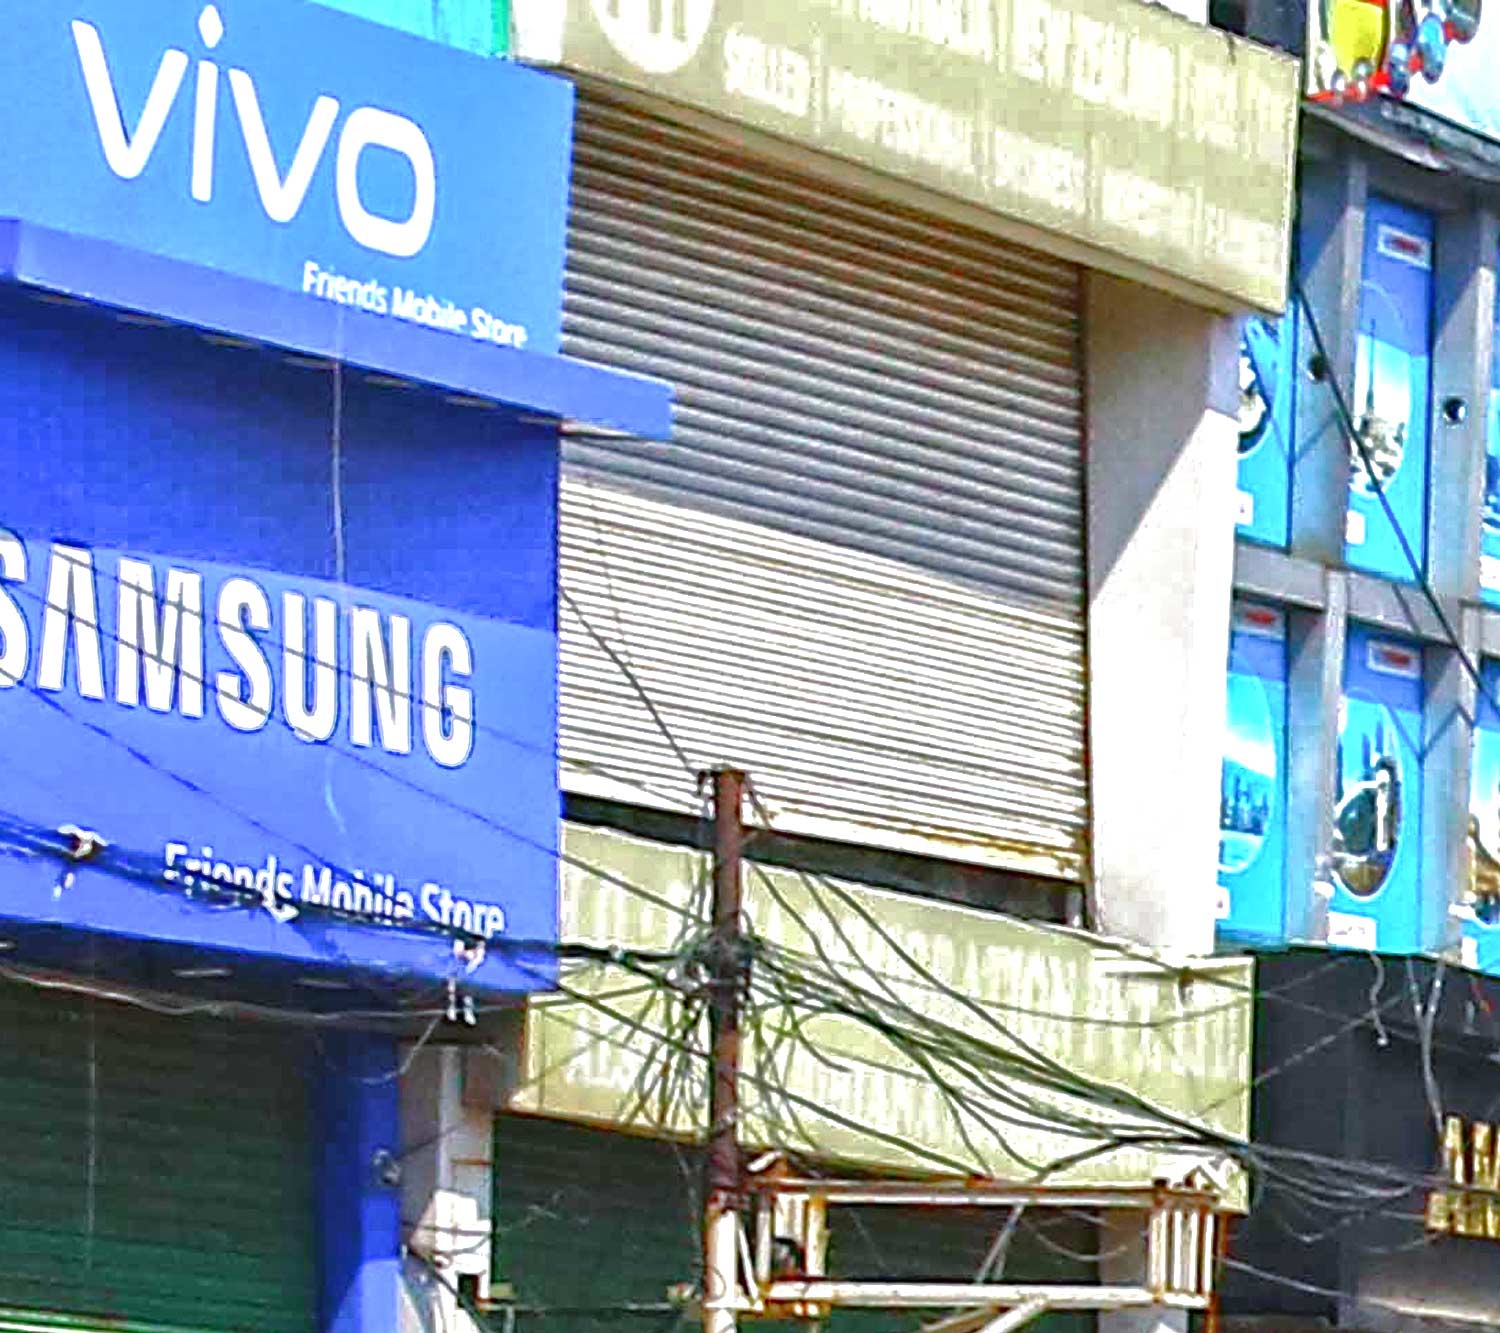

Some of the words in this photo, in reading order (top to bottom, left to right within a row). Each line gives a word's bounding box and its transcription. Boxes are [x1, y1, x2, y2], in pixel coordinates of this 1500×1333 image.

[71, 8, 435, 257] vivo
[302, 262, 388, 317] Friends
[392, 288, 467, 332] Mobile
[469, 306, 528, 350] Store
[0, 528, 474, 768] SAMSUNG
[164, 842, 295, 907] Friends
[301, 862, 413, 920] Mobile
[420, 881, 504, 937] Store
